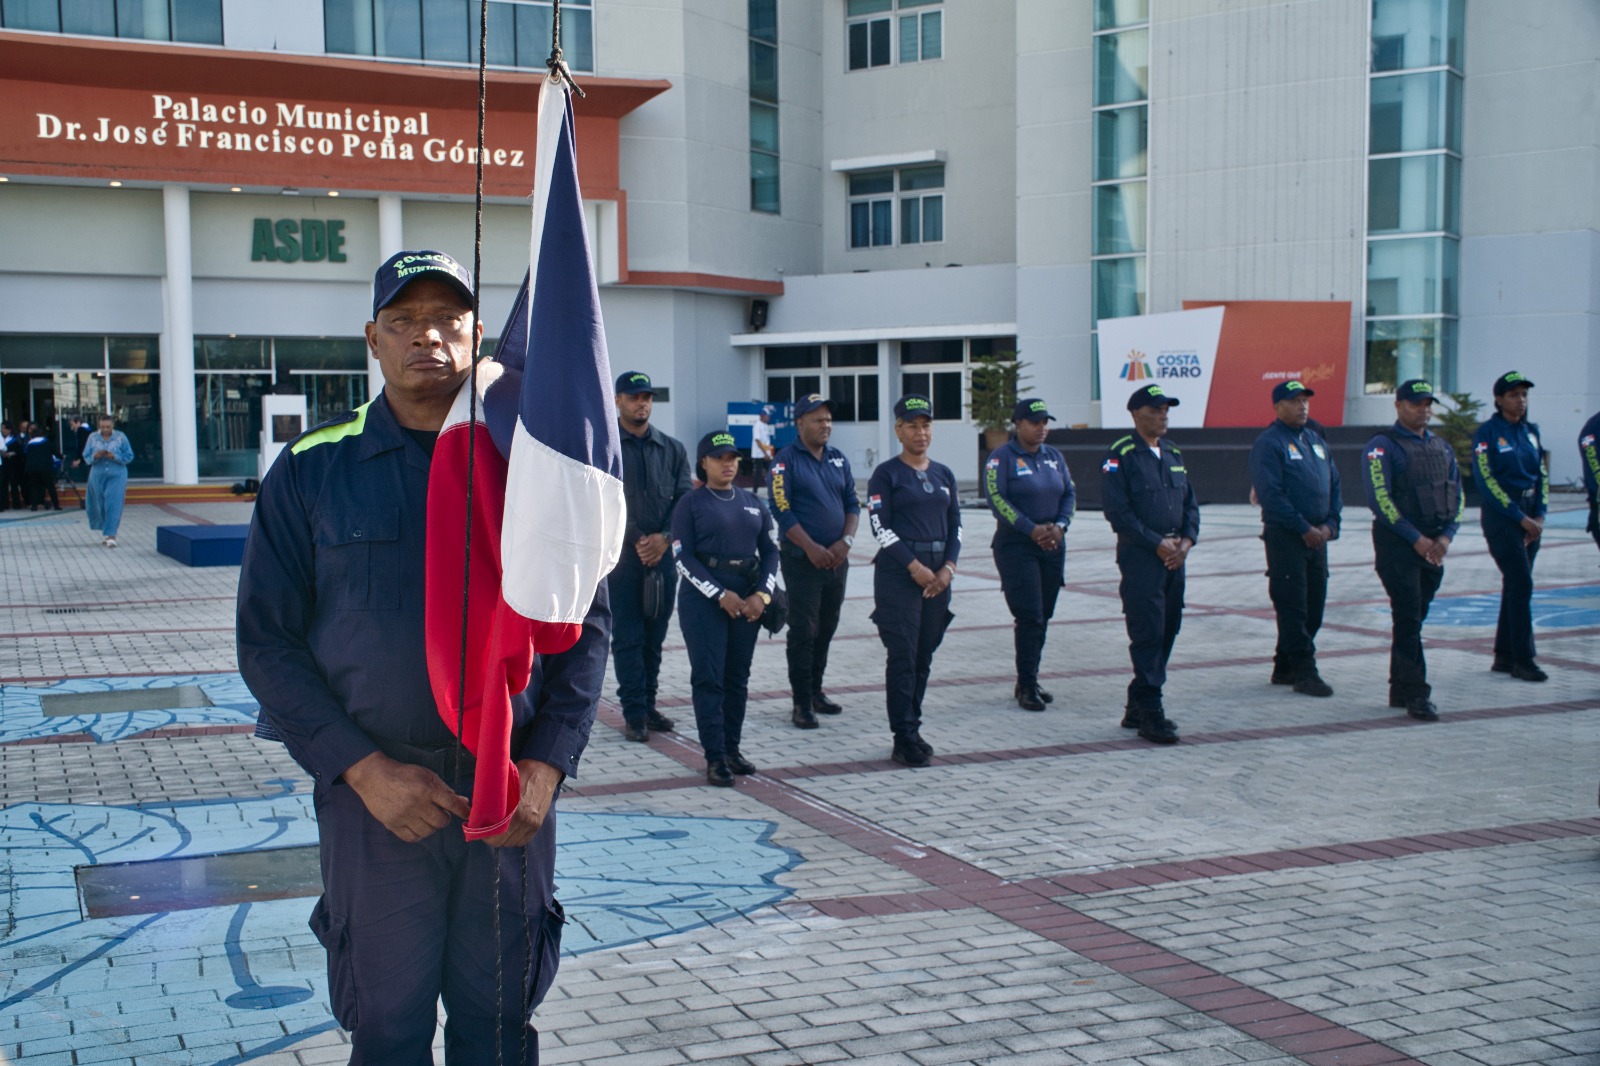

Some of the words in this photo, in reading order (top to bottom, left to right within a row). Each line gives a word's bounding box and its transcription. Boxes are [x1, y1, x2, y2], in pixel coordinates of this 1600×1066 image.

[152, 94, 268, 126] Palacio
[276, 103, 429, 138] Municipal
[36, 113, 87, 141] Dr.
[93, 117, 167, 146] José
[176, 123, 334, 156] Francisco
[342, 133, 414, 161] Peña
[423, 138, 525, 167] Gómez
[251, 218, 347, 264] ASDE
[1156, 355, 1200, 366] COSTA
[1162, 366, 1202, 379] FARO
